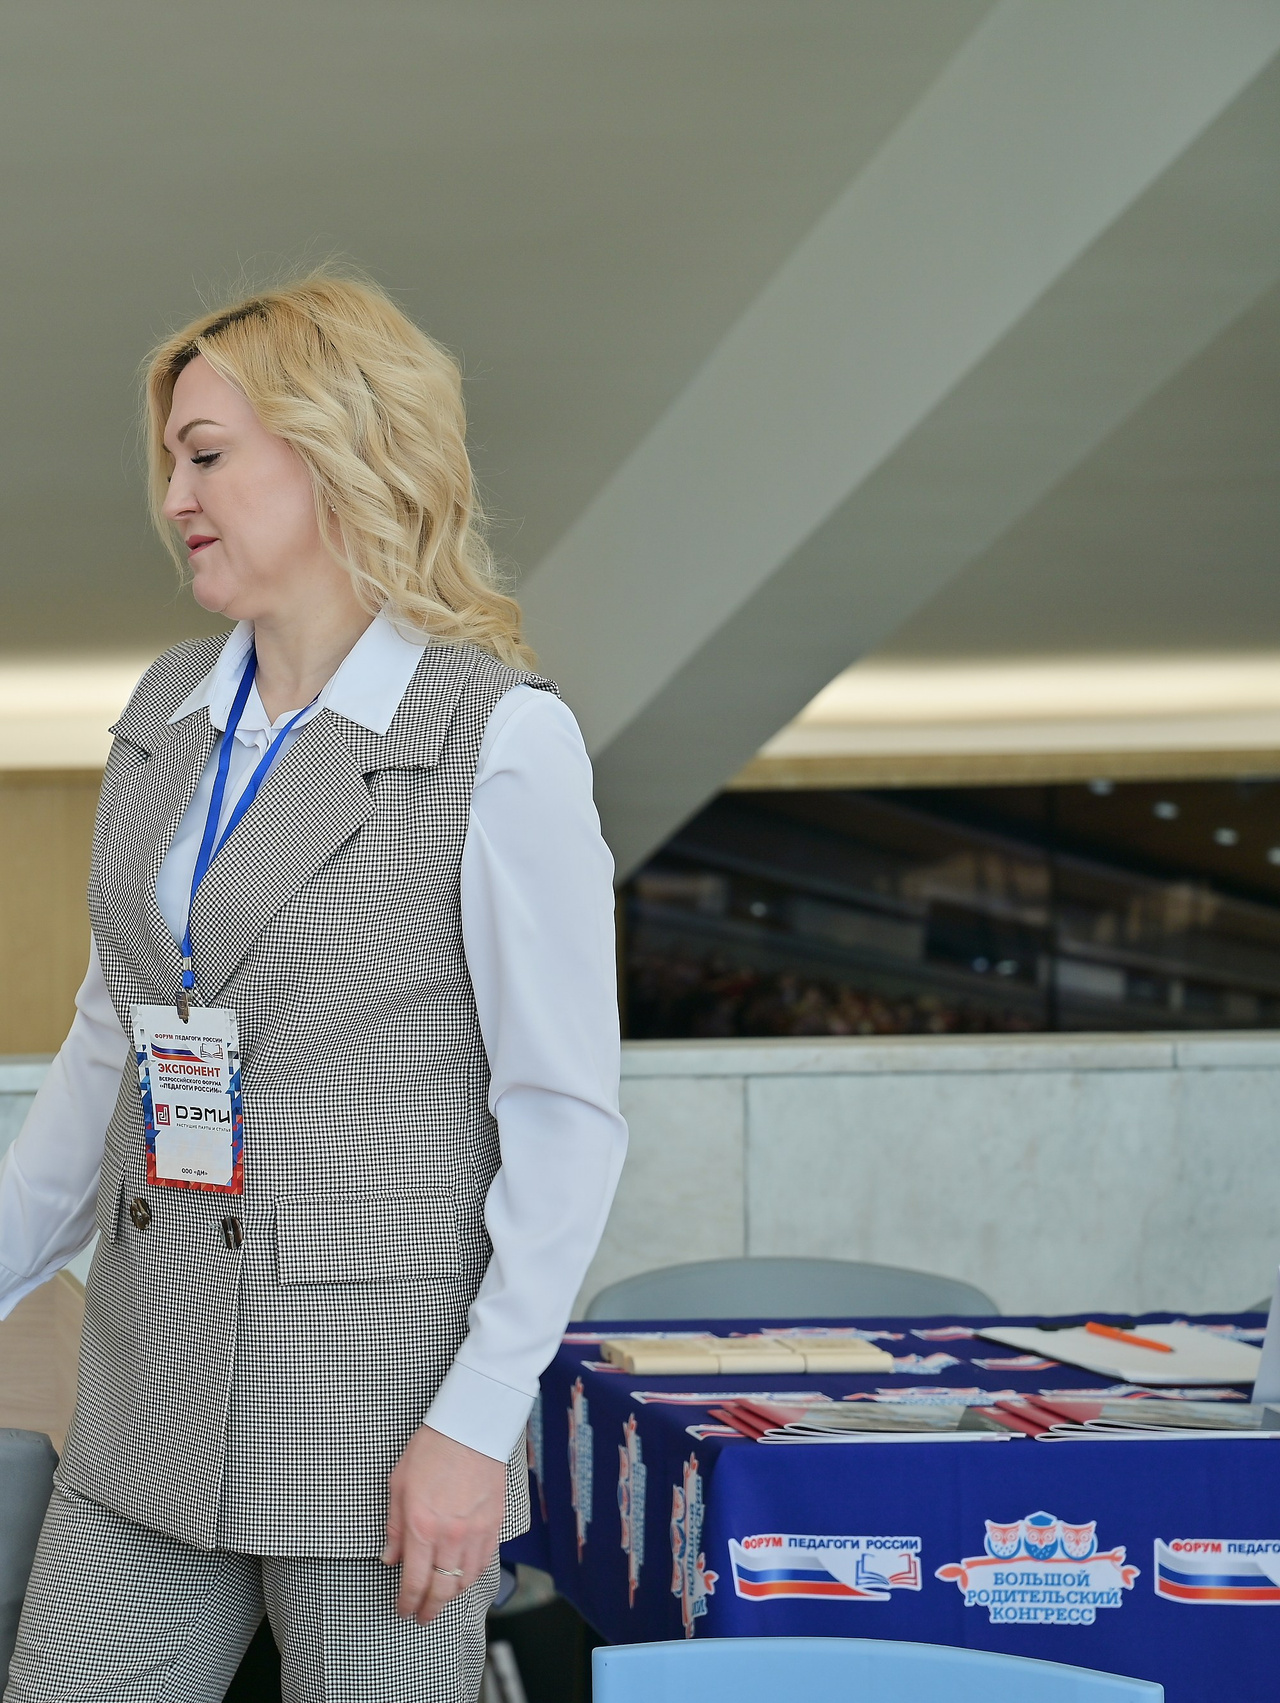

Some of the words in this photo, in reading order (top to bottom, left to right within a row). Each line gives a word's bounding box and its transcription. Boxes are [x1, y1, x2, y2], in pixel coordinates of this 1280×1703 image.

[158, 1063, 221, 1078] ЭКСПОНЕНТ
[159, 1076, 201, 1085] ВСЕРОССИЙСКОГО
[181, 1167, 193, 1175] ООО
[743, 1537, 783, 1550] ФОРУМ
[788, 1538, 860, 1550] ПЕДАГОГИ
[866, 1539, 919, 1550] РОССИИ
[1172, 1542, 1222, 1553] ФОРУМ
[993, 1570, 1091, 1587] БОЛЬШОЙ
[967, 1588, 1120, 1605] РОДИТЕЛЬСКИЙ
[992, 1606, 1093, 1622] КОНГРЕСС
